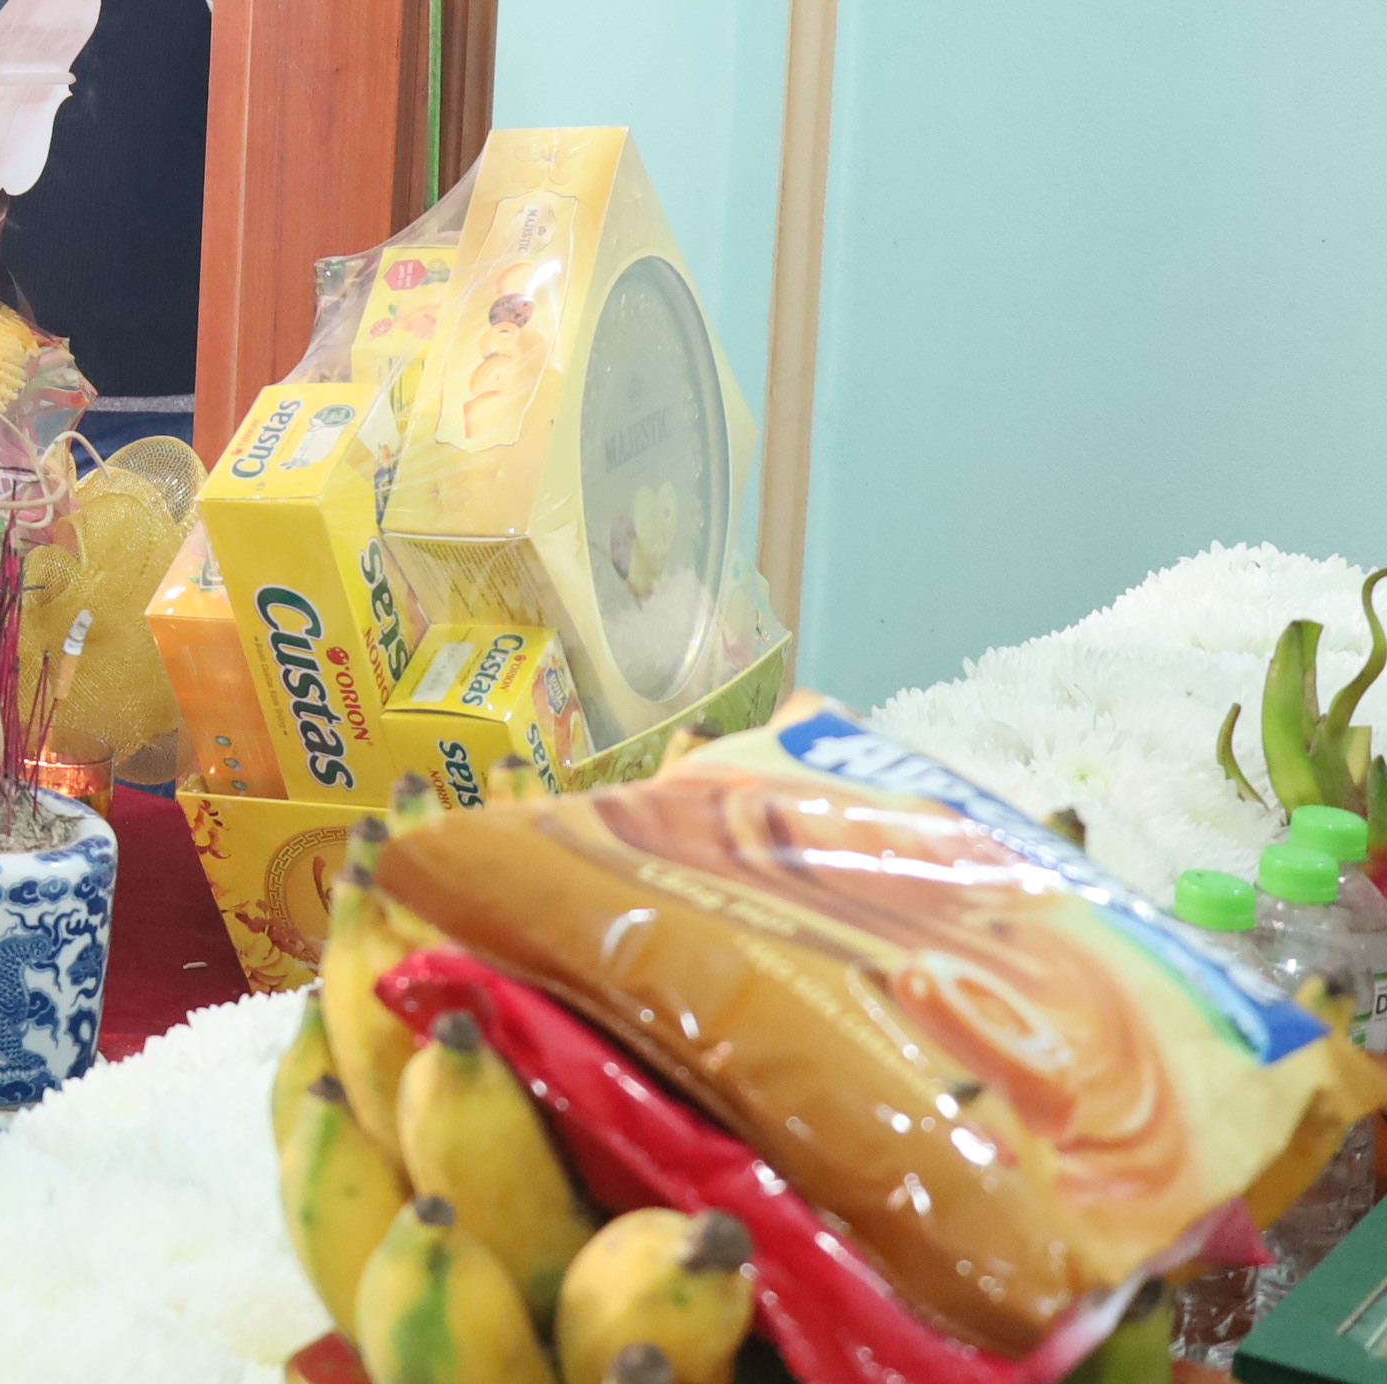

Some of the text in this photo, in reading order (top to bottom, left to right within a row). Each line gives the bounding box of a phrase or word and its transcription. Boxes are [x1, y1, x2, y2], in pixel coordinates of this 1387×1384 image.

[517, 209, 539, 253] MAJESTIC
[231, 399, 302, 478] Custas
[256, 586, 355, 790] Custas
[462, 634, 524, 707] Custas
[500, 662, 521, 691] ORION
[335, 671, 371, 741] ORION
[430, 770, 452, 811] ORION
